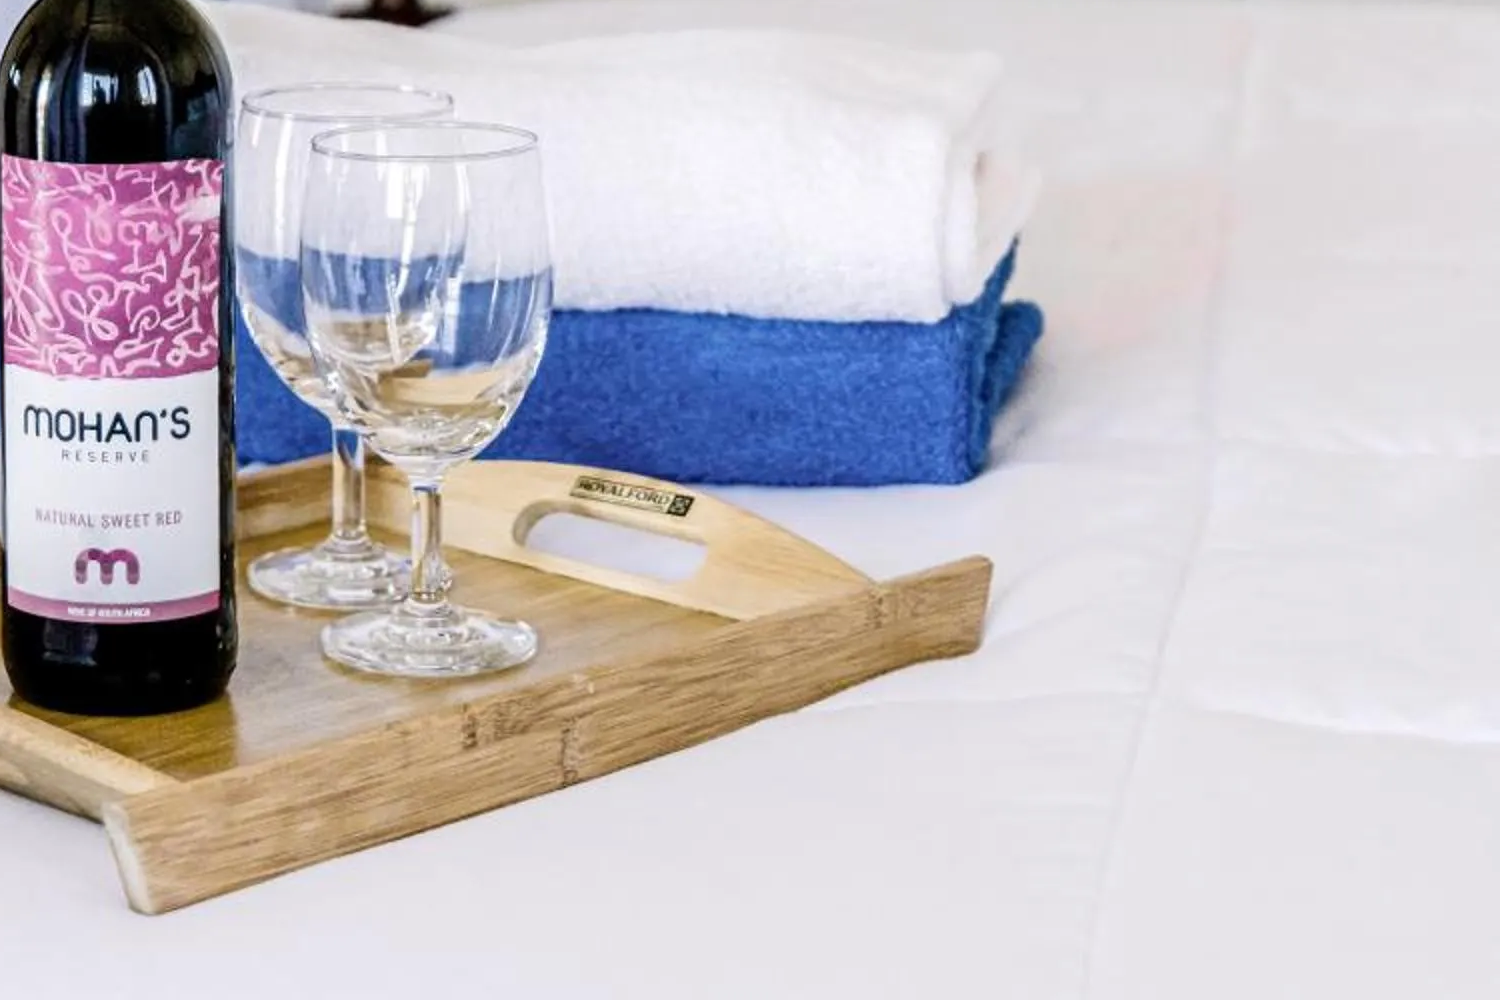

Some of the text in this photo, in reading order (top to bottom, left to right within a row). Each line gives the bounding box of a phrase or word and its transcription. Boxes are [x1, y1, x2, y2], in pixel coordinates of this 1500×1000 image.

[24, 404, 191, 443] MOHAN'S
[61, 449, 149, 463] RESERVE
[578, 479, 670, 505] ROYALFORD
[35, 507, 183, 529] NATURAL SWEET RED
